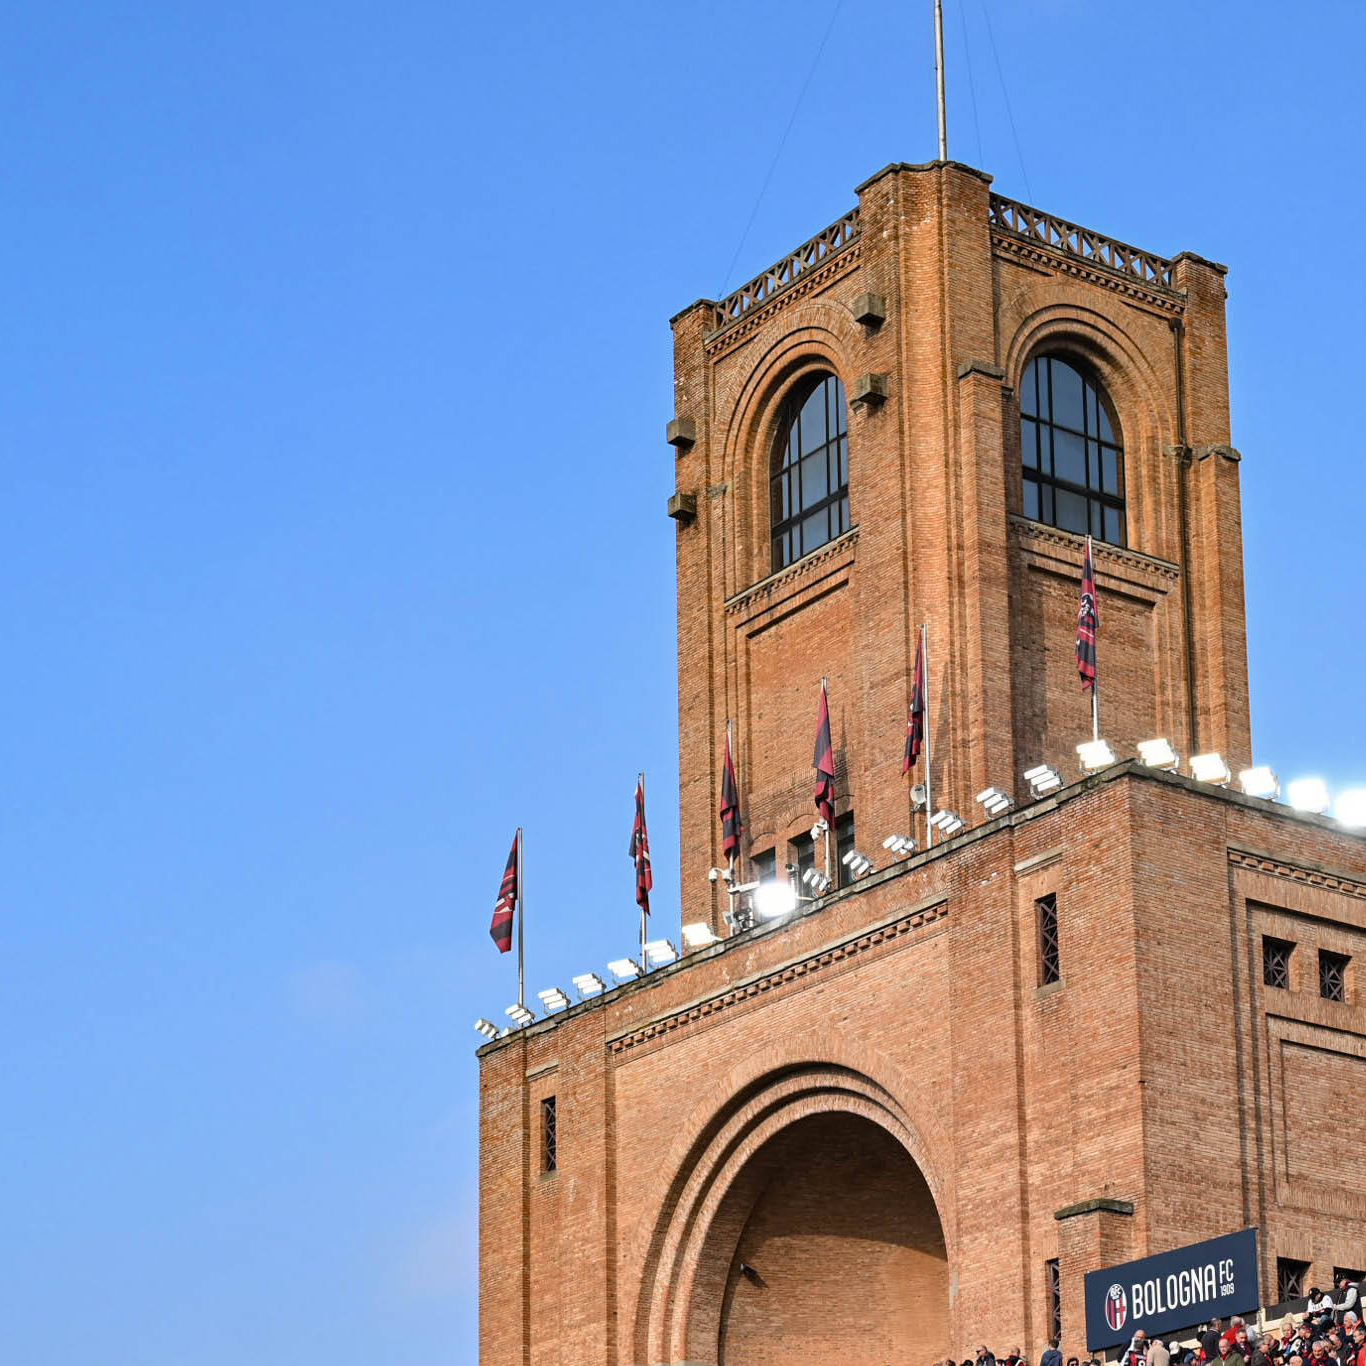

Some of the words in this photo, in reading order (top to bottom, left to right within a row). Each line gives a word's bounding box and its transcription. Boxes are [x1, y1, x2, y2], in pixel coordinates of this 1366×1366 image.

[1132, 1264, 1217, 1320] BOLOGNA
[1219, 1258, 1234, 1284] FC
[1220, 1281, 1235, 1297] 1909
